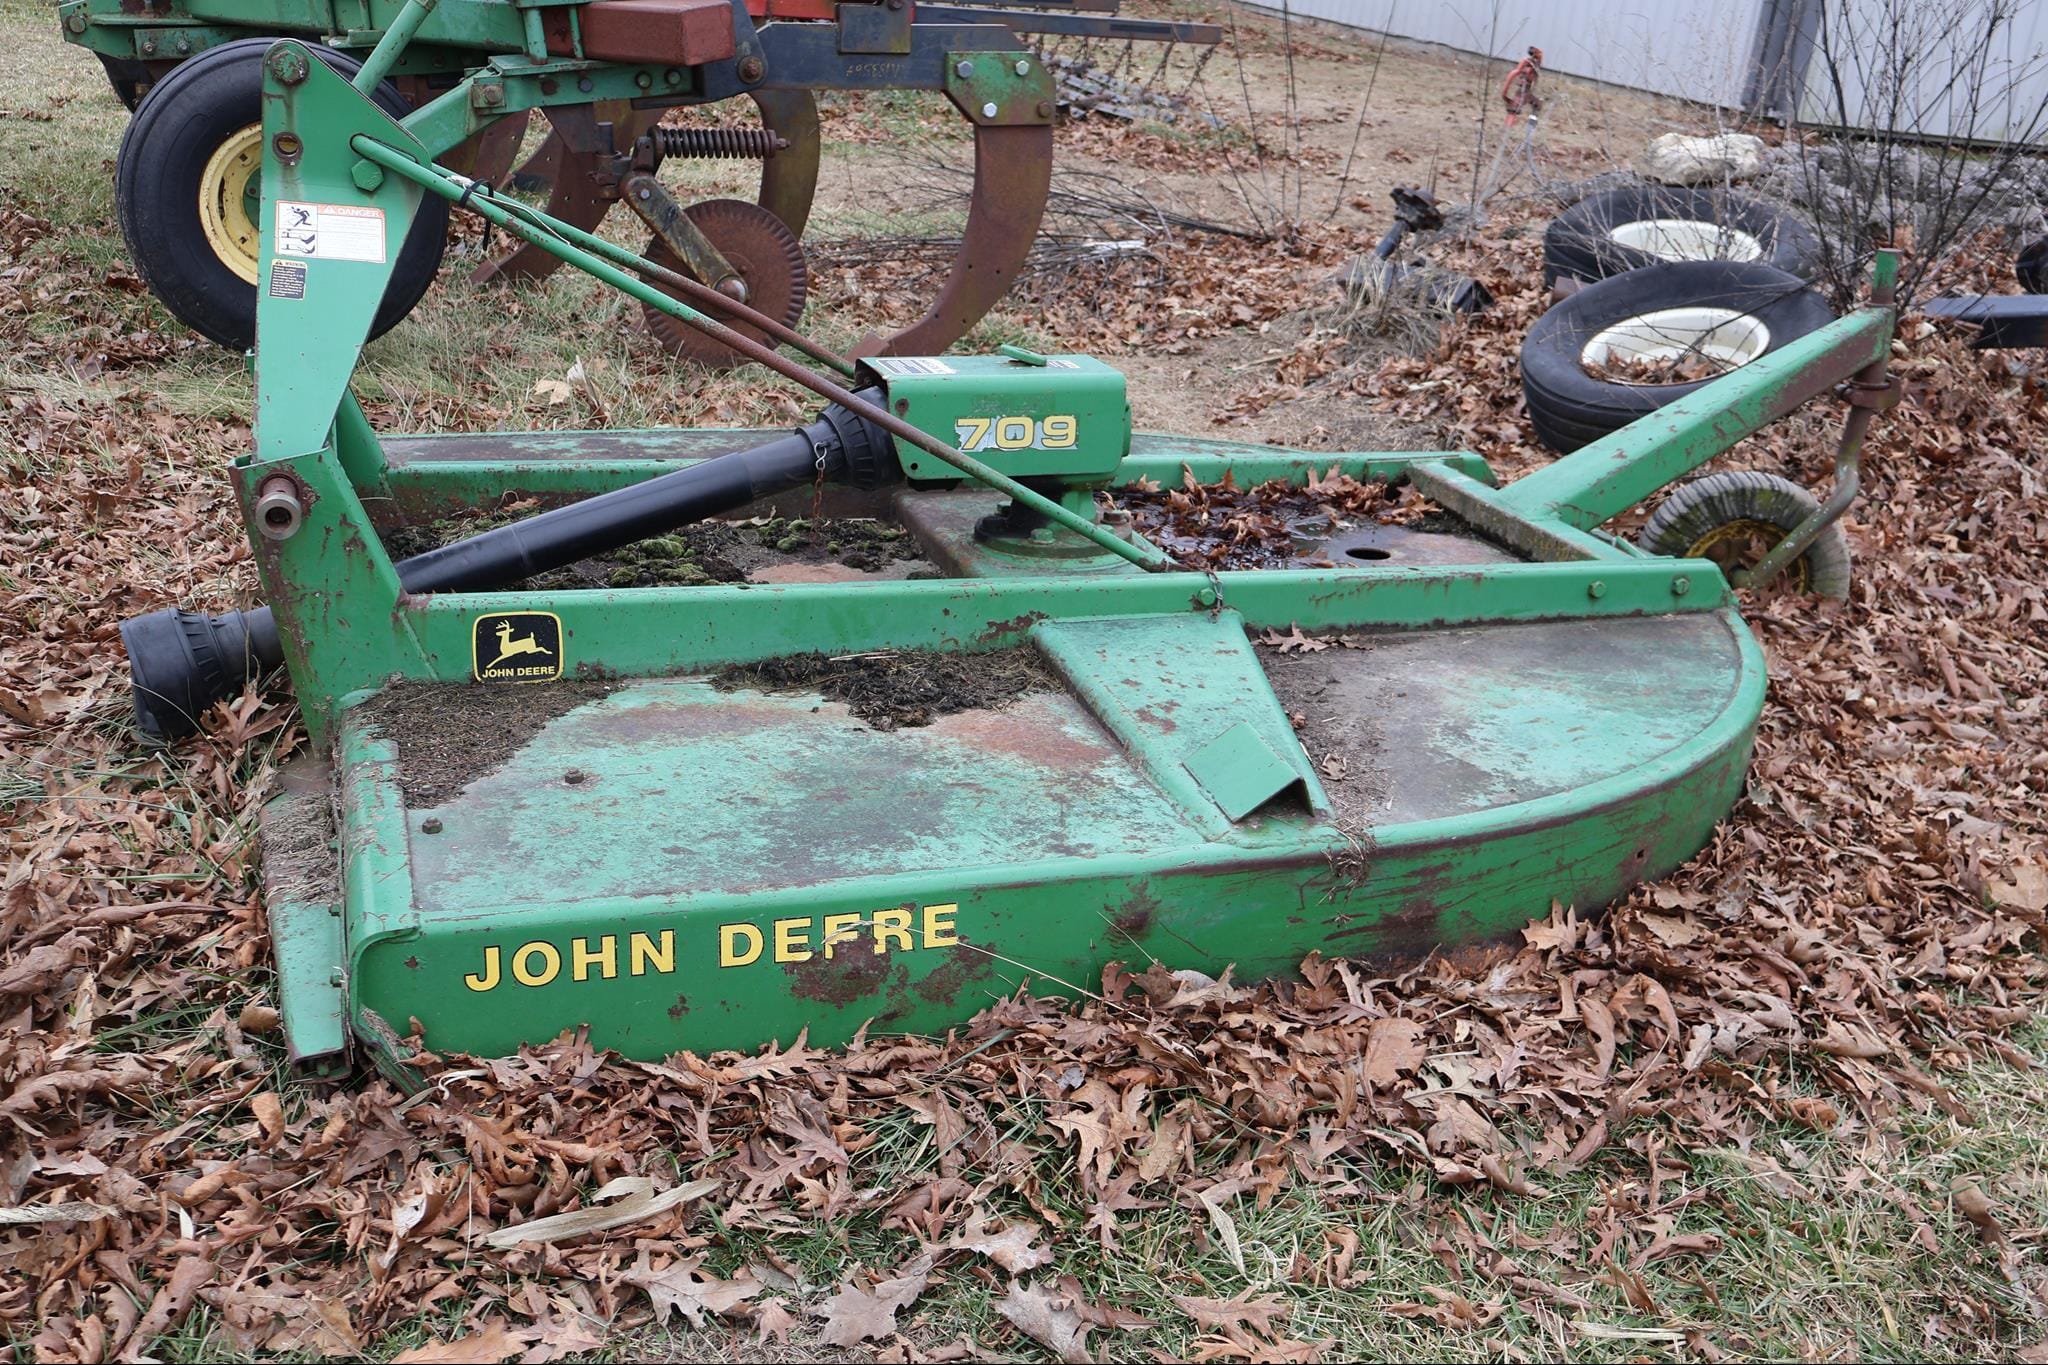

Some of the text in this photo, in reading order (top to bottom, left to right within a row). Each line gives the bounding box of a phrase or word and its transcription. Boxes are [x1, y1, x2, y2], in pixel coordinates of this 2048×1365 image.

[337, 208, 379, 217] DANGER
[956, 413, 1077, 450] 709
[482, 666, 555, 678] JOHN DEERE
[464, 929, 675, 993] JOHN
